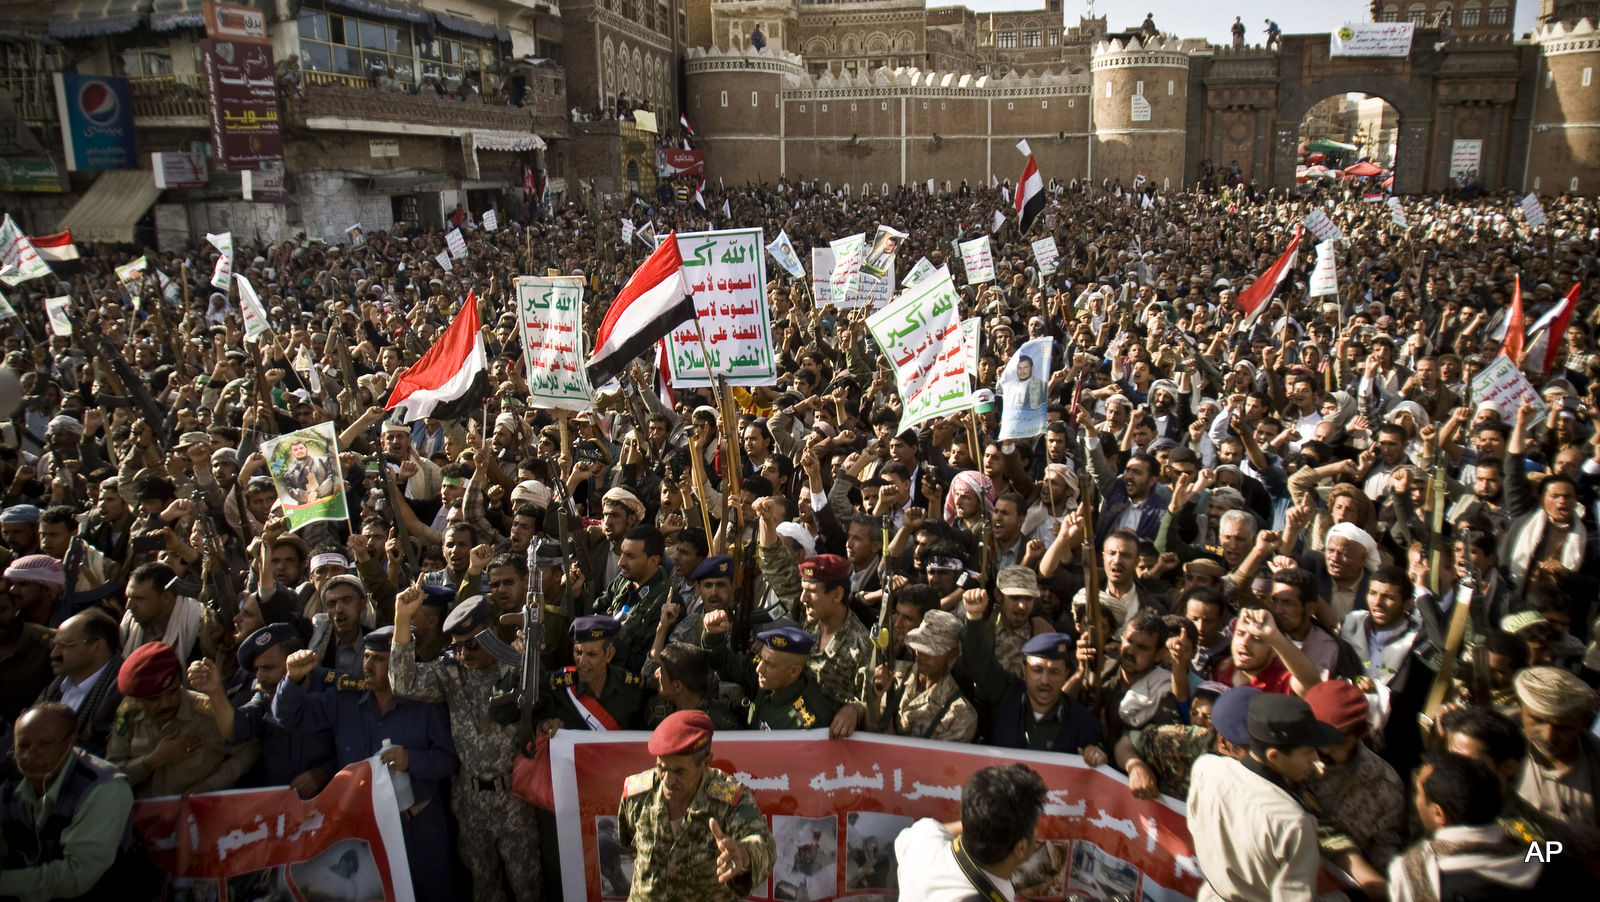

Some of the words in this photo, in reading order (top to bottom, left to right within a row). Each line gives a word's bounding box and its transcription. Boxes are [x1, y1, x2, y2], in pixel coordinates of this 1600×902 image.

[224, 108, 278, 124] سويد
[683, 238, 717, 267] أك
[691, 272, 714, 296] لأمر
[717, 273, 757, 294] الموت
[696, 300, 716, 322] لإسر
[720, 299, 759, 319] الموت
[709, 326, 728, 345] على
[731, 324, 762, 340] اللعنة
[726, 344, 766, 373] النصر
[217, 808, 326, 862] جرائم
